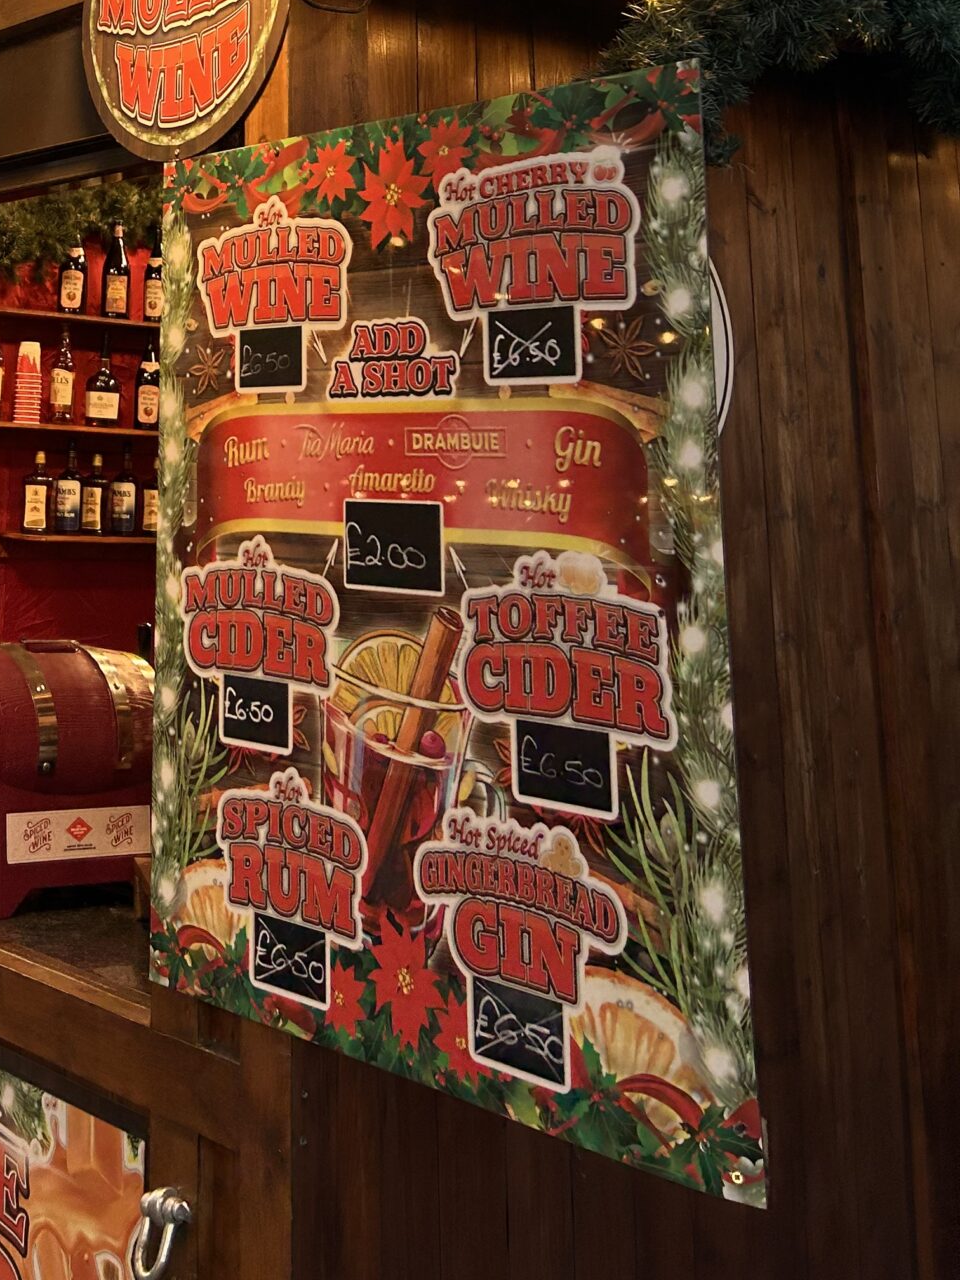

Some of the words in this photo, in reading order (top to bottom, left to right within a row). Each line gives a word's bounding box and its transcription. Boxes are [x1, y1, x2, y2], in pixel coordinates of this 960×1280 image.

[116, 1, 250, 127] WINE
[445, 175, 476, 202] Hot
[479, 161, 589, 199] CHERRY
[257, 203, 283, 227] Hot
[435, 189, 632, 257] MULLED
[202, 227, 345, 281] MULLED
[442, 233, 627, 312] WINE
[206, 263, 342, 329] WINE
[241, 345, 290, 377] £6.50
[350, 321, 426, 361] ADD
[330, 361, 358, 397] A
[362, 357, 454, 397] SHOT
[224, 436, 270, 467] Rum
[318, 422, 375, 461] Maria
[412, 433, 500, 450] DRAMBUIE
[554, 426, 602, 472] Gin
[57, 488, 76, 496] AMB'S
[113, 490, 131, 498] AMB'S
[244, 476, 305, 508] Brandy
[348, 464, 436, 496] Amaretto
[486, 479, 572, 524] Whisky
[243, 543, 268, 567] Hot
[346, 522, 426, 569] £2.00
[185, 570, 333, 626] MULLED
[521, 560, 556, 589] Hot
[190, 608, 330, 687] CIDER
[468, 593, 658, 665] TOFFEE
[225, 687, 274, 723] £6.50
[465, 642, 670, 740] CIDER
[520, 735, 604, 788] £6.50
[275, 776, 302, 803] Hot
[31, 831, 53, 849] WINE
[112, 825, 134, 844] WINE
[222, 798, 363, 870] SPICED
[448, 818, 481, 848] Hot
[487, 826, 544, 859] Spiced
[229, 841, 357, 939] RUM
[420, 851, 620, 944] GINGERBREAD
[453, 897, 581, 1005] GIN
